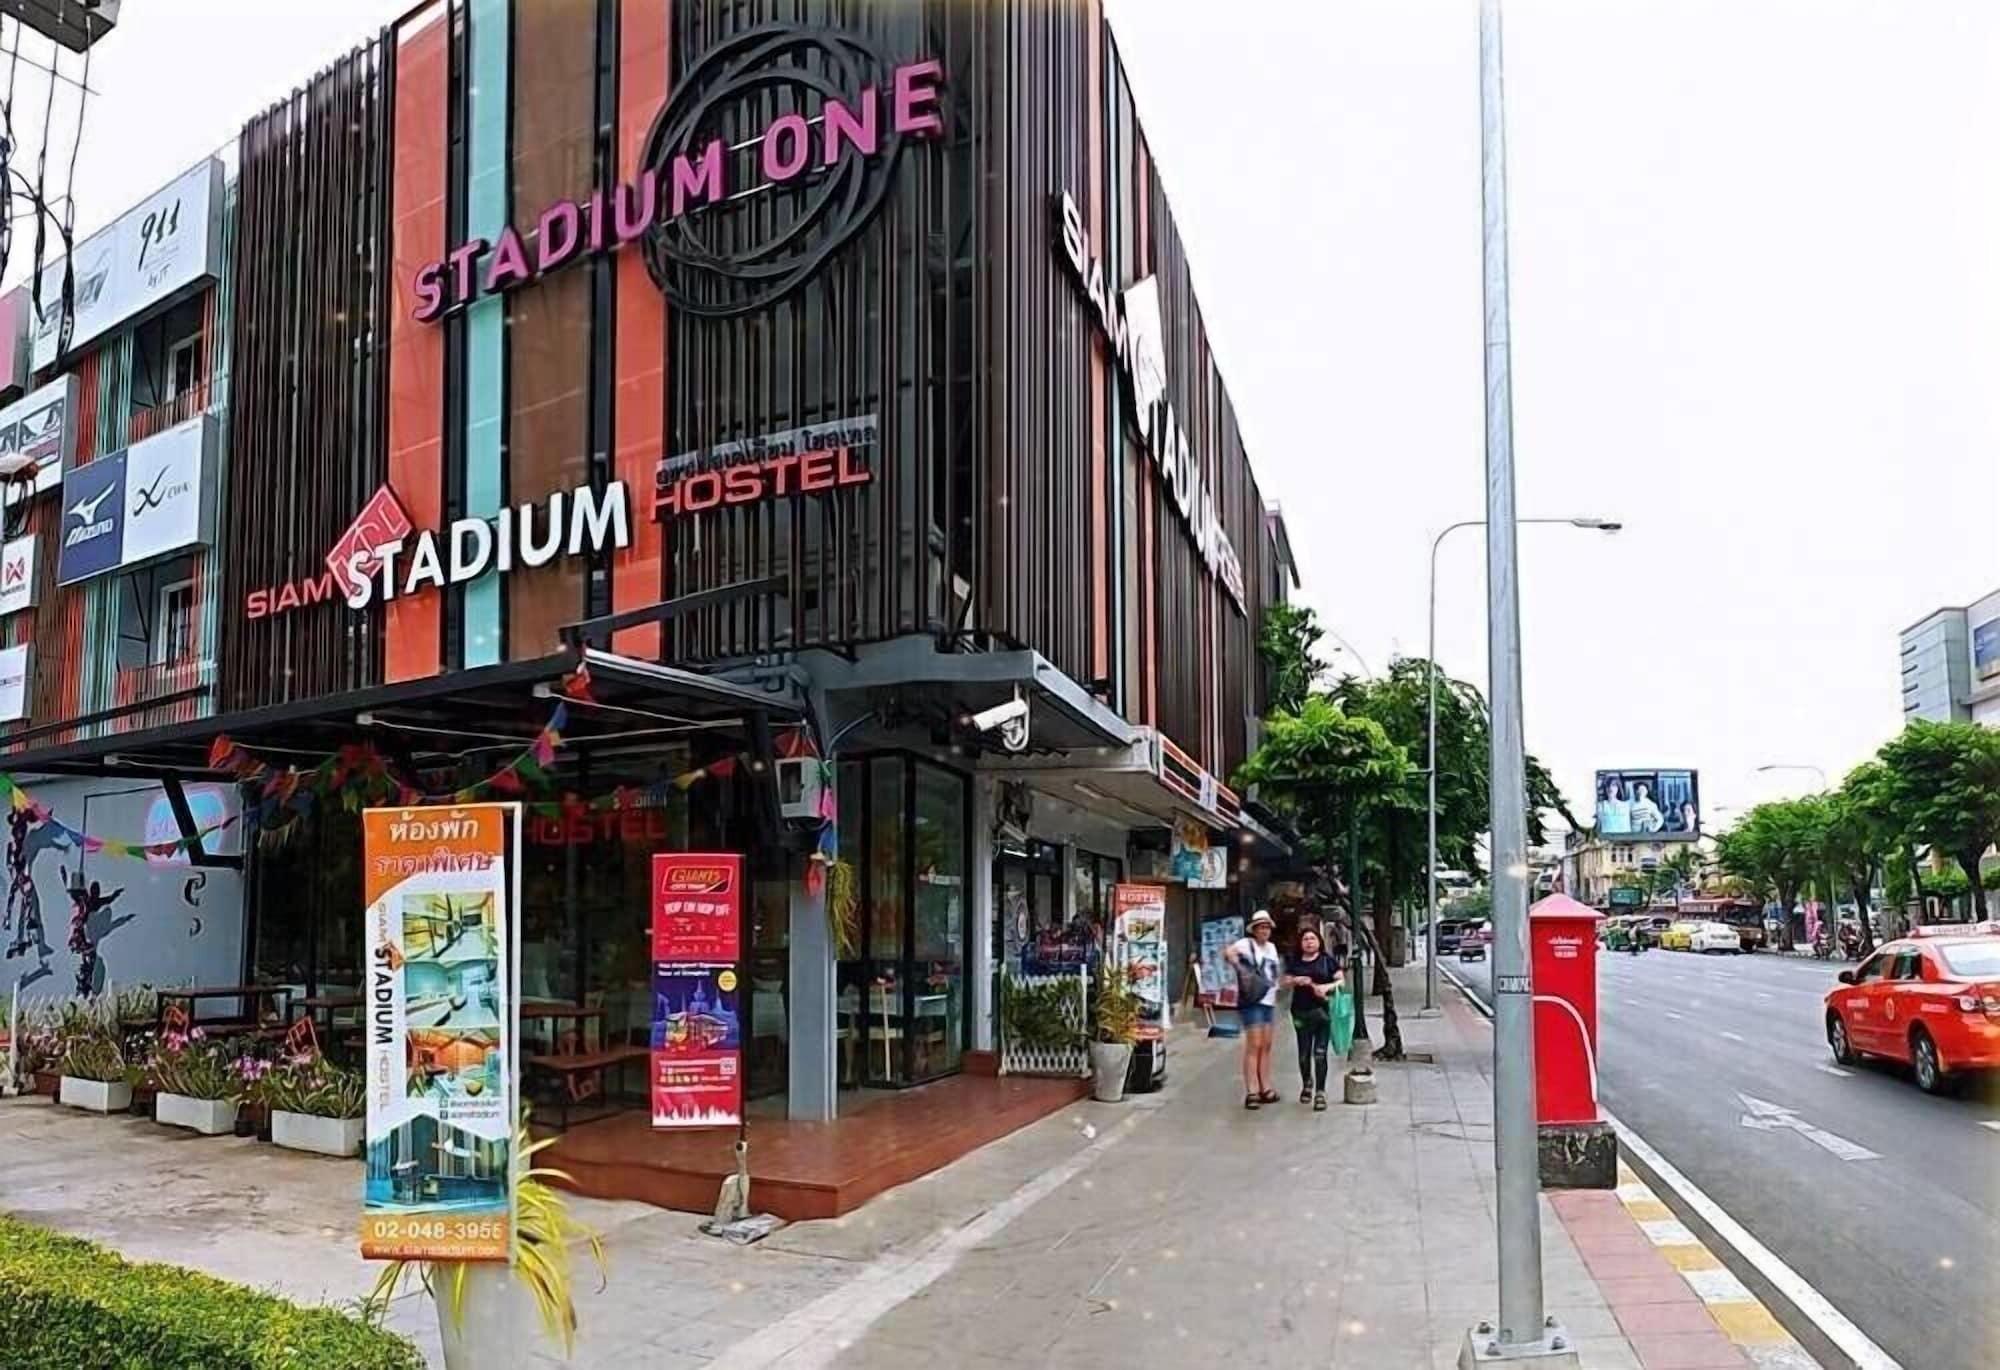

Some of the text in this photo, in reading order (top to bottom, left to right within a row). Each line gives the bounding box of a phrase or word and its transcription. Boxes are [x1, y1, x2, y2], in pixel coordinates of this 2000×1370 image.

[412, 58, 944, 324] STADIUM ONE
[1062, 189, 1128, 373] SIAM
[1137, 395, 1217, 581] TADIUM
[247, 446, 870, 619] SIAM STADIUM HOSTEL
[389, 811, 479, 842] ห้องพัก
[375, 948, 394, 1045] STADIUM
